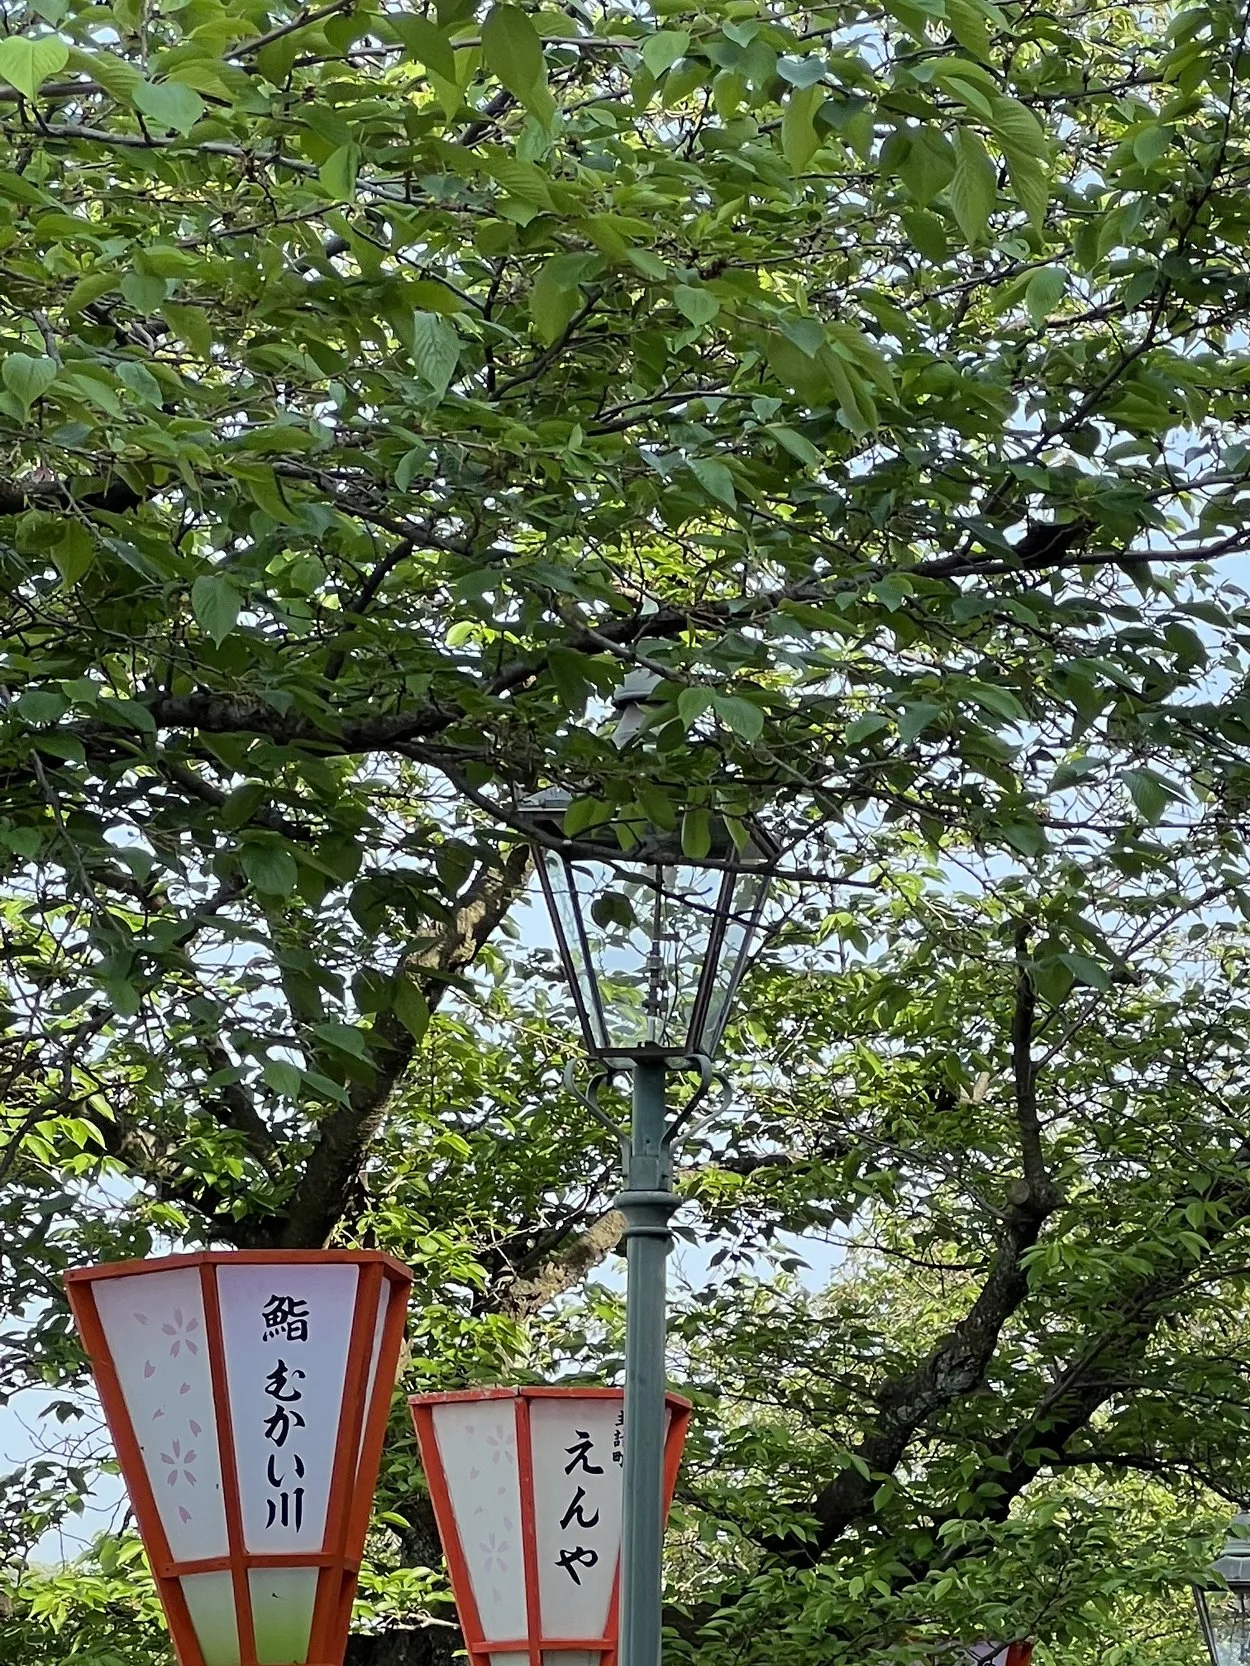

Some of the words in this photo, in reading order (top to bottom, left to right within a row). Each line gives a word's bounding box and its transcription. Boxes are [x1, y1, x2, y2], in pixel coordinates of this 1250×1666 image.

[261, 1294, 310, 1343] 鮨
[263, 1358, 306, 1533] むかい川
[554, 1429, 605, 1586] えんや
